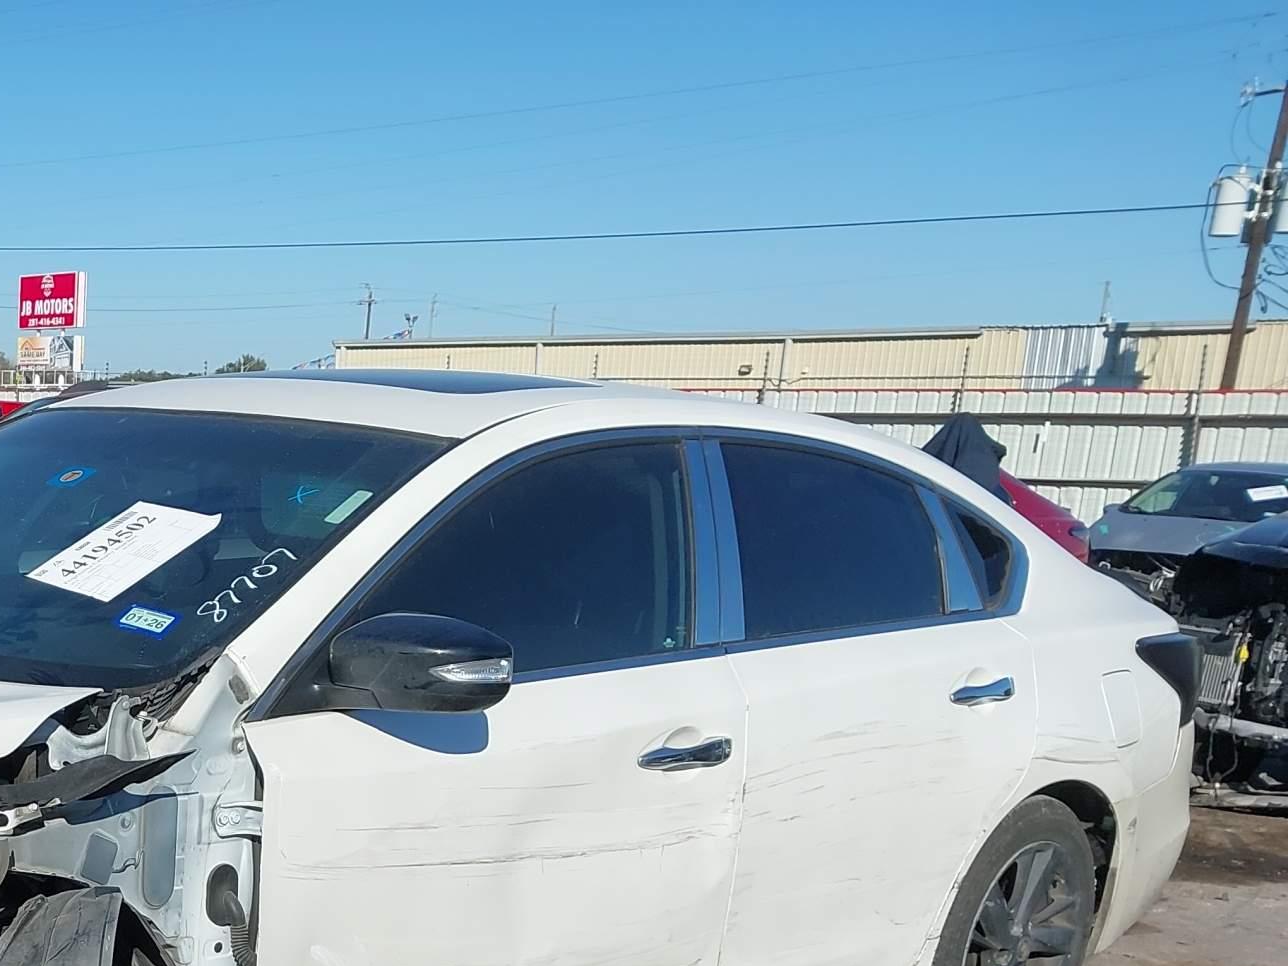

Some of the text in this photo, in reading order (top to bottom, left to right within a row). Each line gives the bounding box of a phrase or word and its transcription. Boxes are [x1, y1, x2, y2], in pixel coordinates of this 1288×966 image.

[21, 298, 73, 316] JB MOTORS
[61, 515, 157, 577] 44194502
[196, 547, 297, 622] 87707
